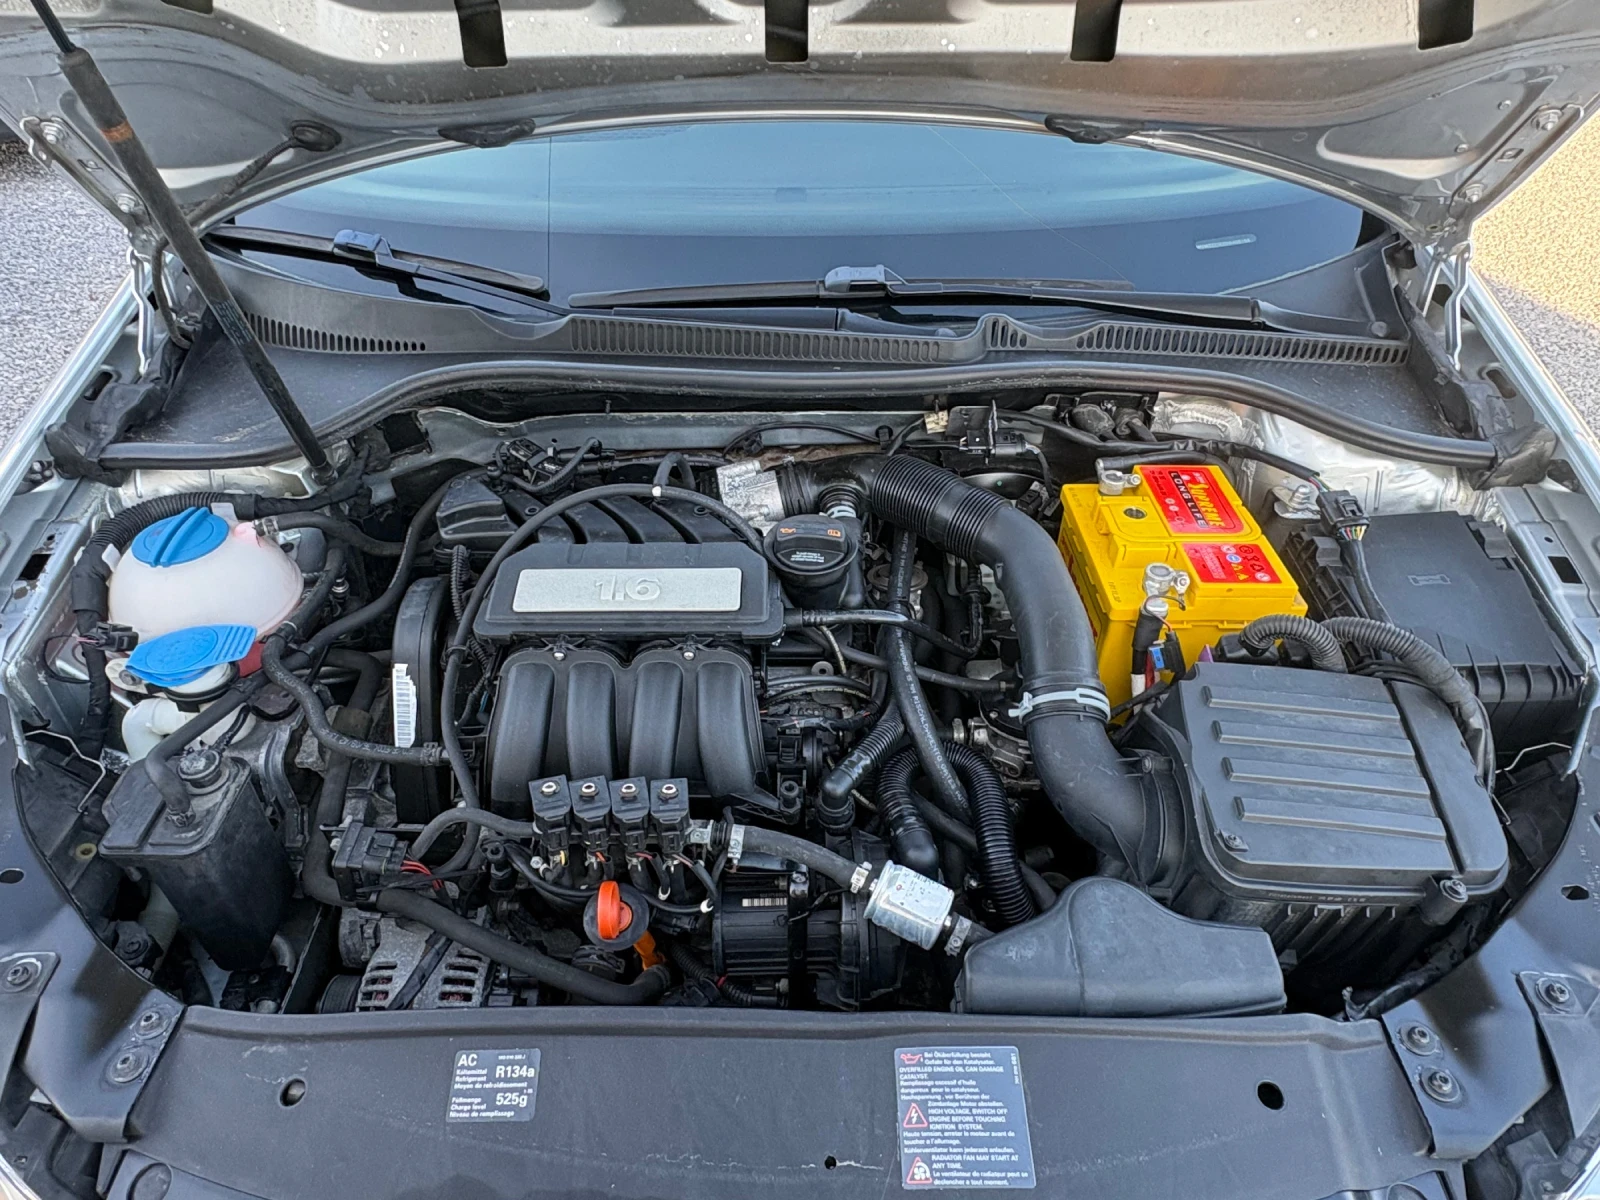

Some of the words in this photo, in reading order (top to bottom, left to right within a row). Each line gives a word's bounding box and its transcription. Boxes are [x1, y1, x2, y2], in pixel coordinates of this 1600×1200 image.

[1170, 472, 1192, 499] LONG
[1188, 502, 1207, 528] LIFE
[1187, 483, 1226, 527] SUPREME
[595, 575, 661, 601] 1.6
[457, 1053, 478, 1067] AC
[495, 1065, 535, 1078] R134a
[455, 1075, 487, 1083] Refrigerant
[495, 1092, 528, 1107] 525g
[449, 1110, 470, 1118] Niveau
[479, 1110, 515, 1118] remplissage
[974, 1115, 1006, 1123] TOUCHING
[963, 1146, 989, 1154] jederzeit
[970, 1178, 983, 1186] tout
